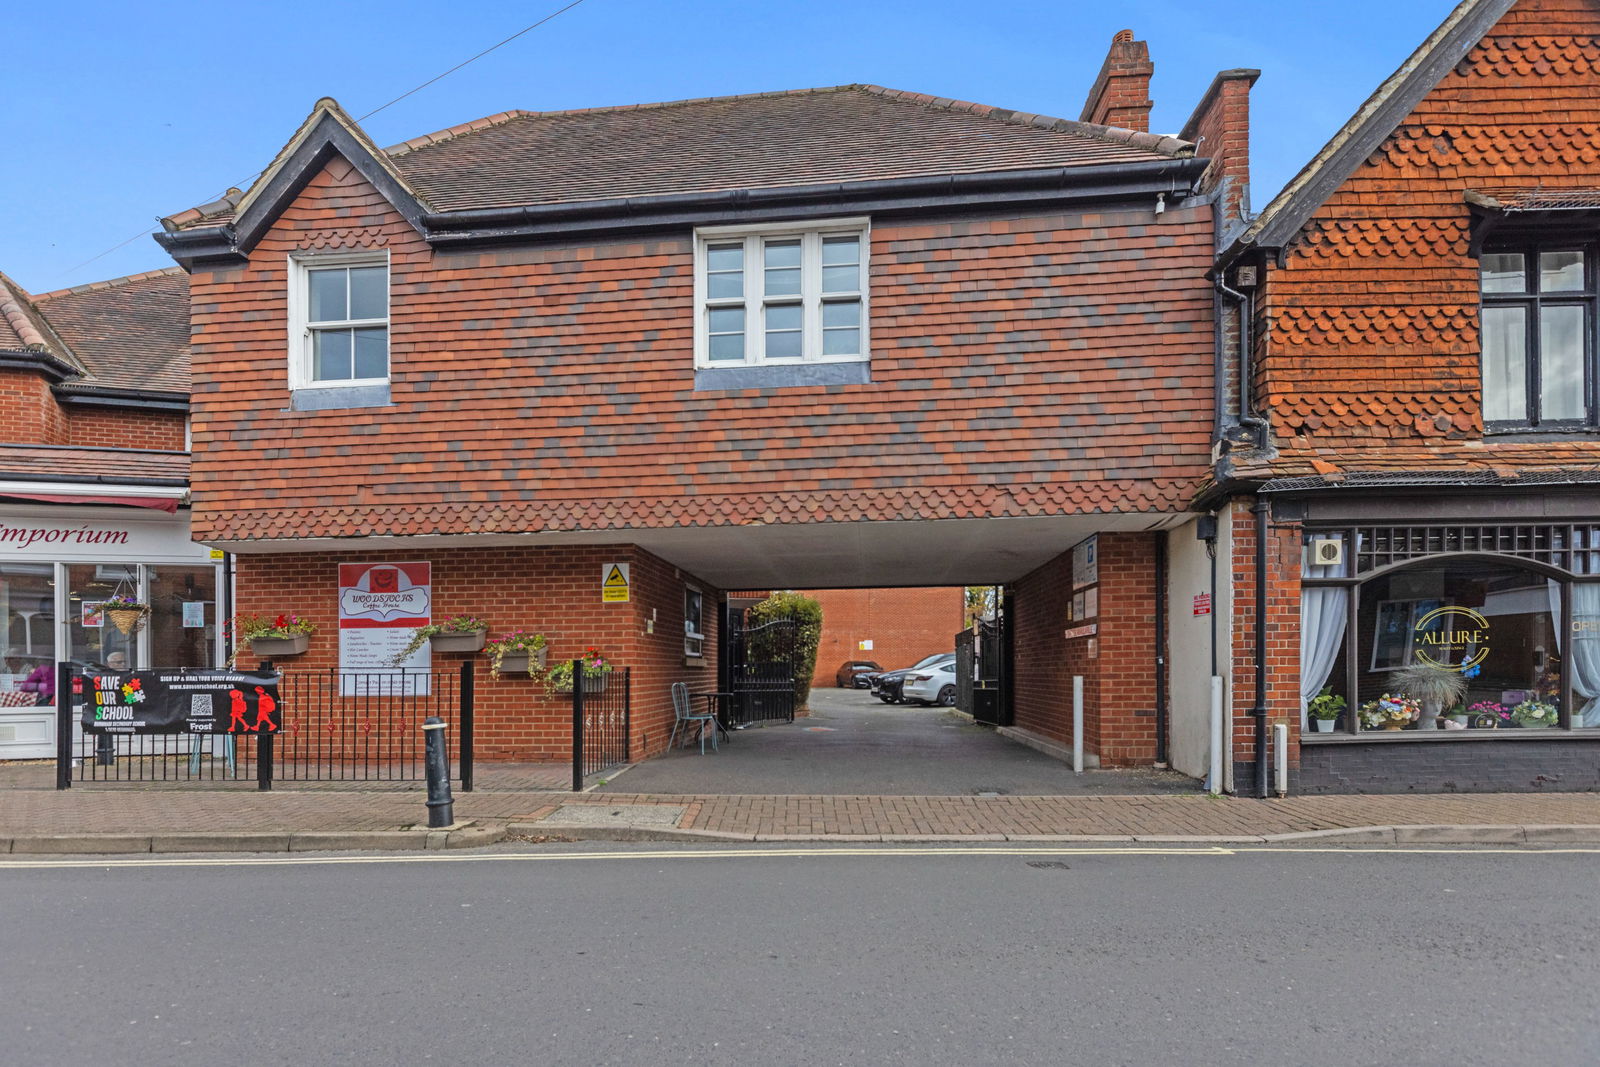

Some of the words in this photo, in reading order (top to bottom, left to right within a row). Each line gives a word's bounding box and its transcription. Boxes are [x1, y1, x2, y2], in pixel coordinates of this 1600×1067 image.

[0, 524, 128, 548] mporium
[352, 594, 414, 603] WOODSTOCKS
[1421, 630, 1483, 645] ALLURE
[93, 676, 120, 690] SAVE
[95, 691, 117, 705] OUR
[95, 706, 134, 720] SCHOOL
[190, 722, 213, 730] Frost
